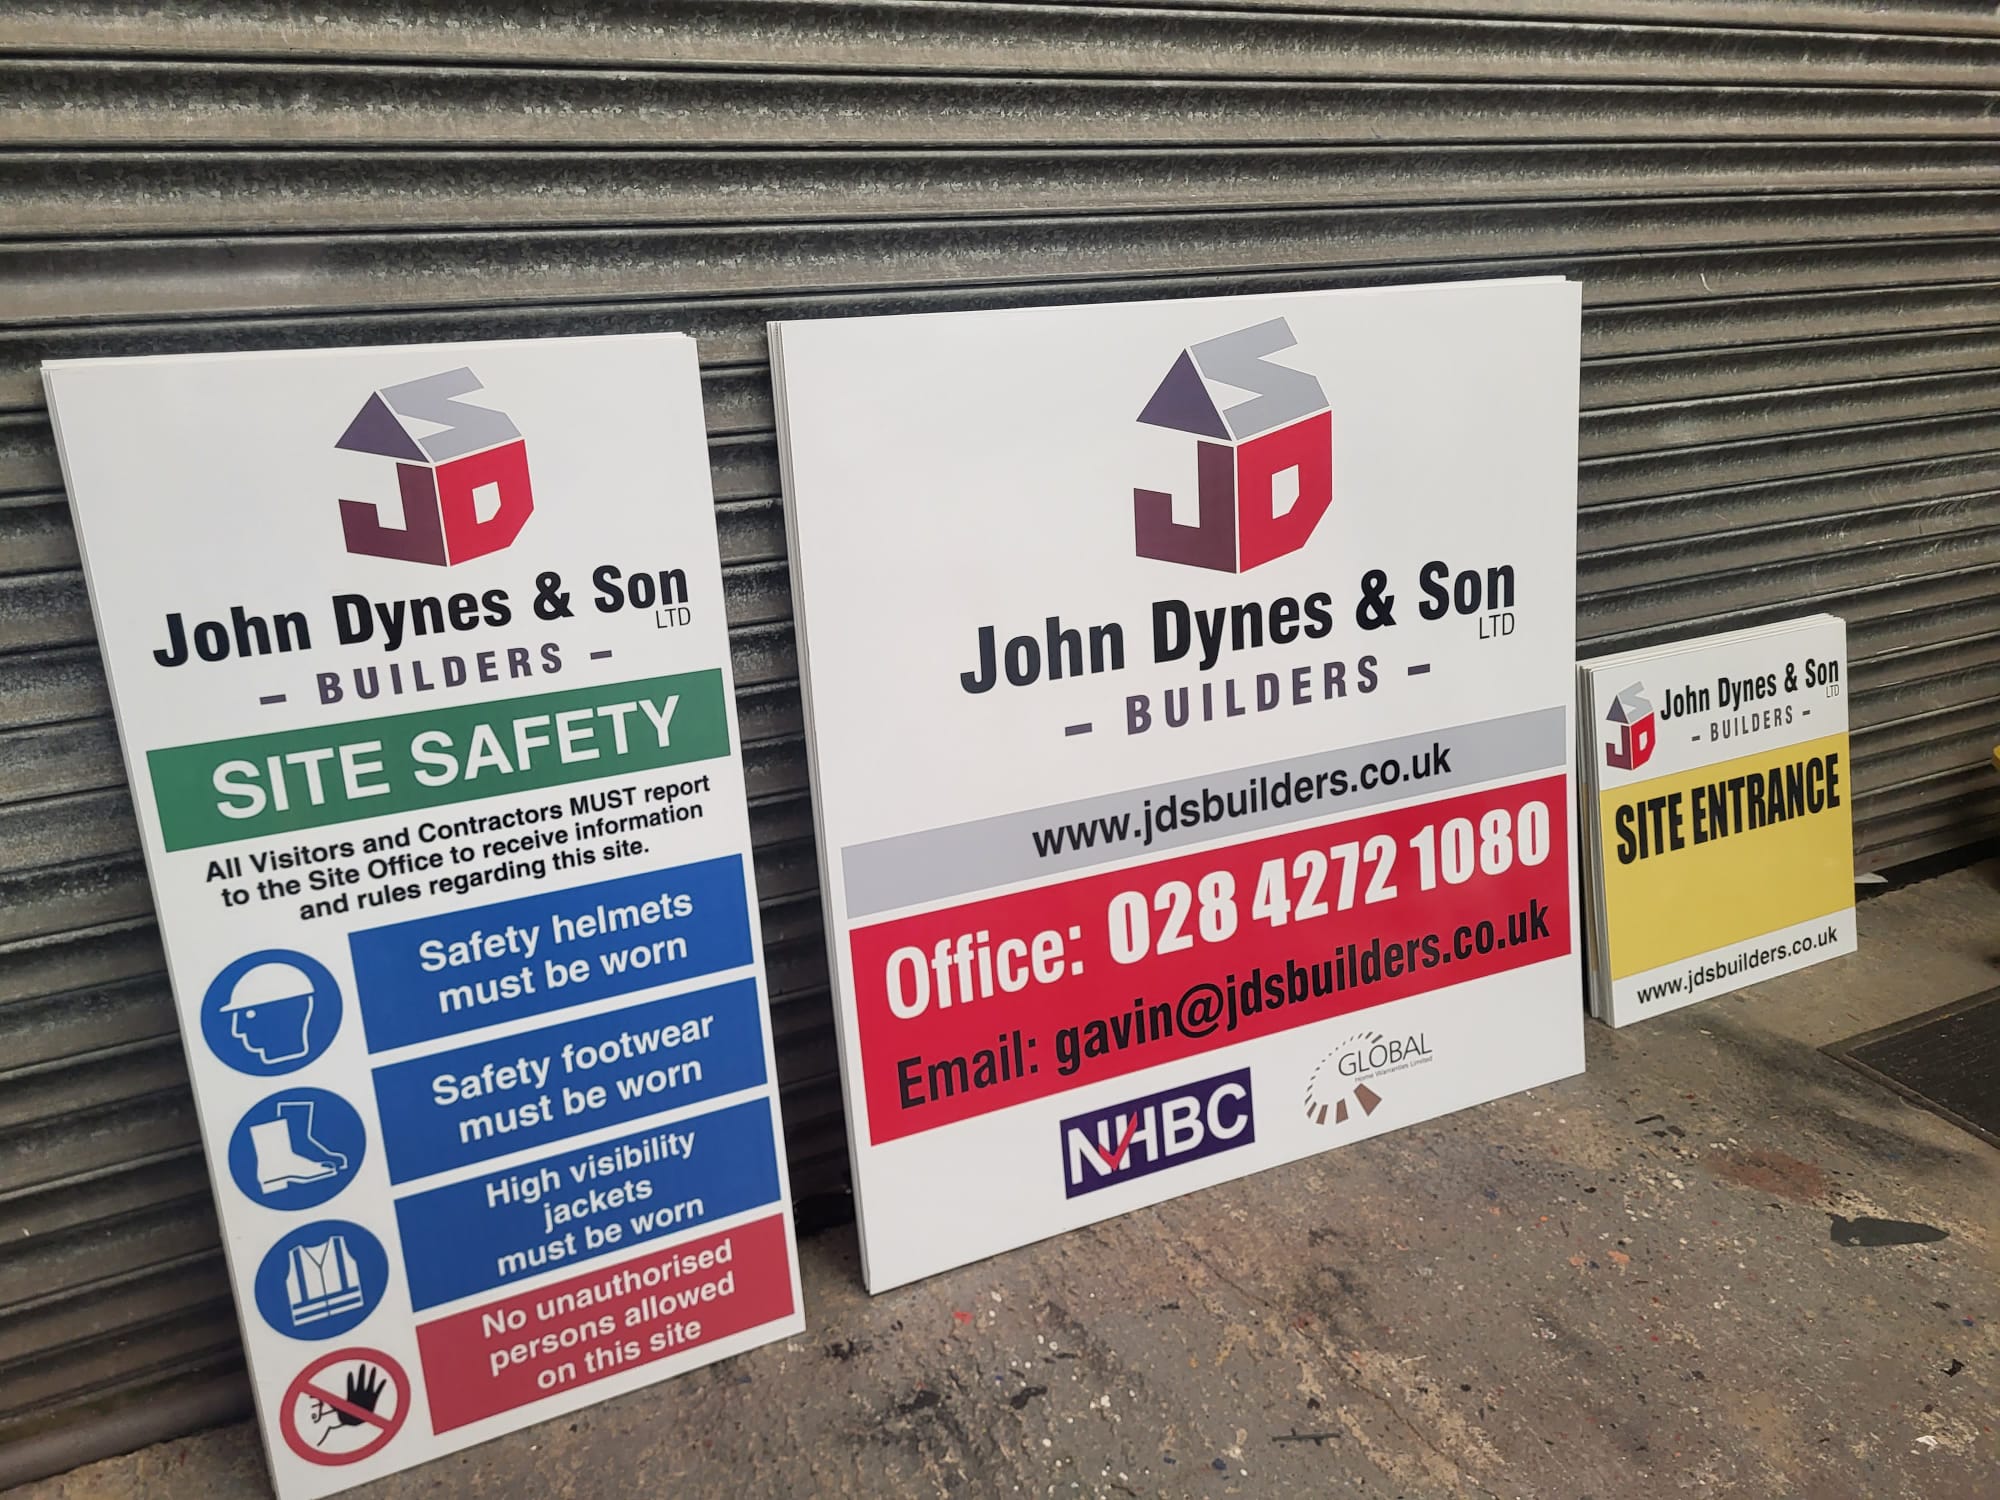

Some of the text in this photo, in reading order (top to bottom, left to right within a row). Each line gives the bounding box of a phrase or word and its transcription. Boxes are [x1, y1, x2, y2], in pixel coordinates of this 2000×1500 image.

[153, 565, 688, 667] John Dynes & Son
[656, 607, 690, 628] LTD
[960, 561, 1514, 694] John Dynes & Son
[1480, 613, 1514, 639] LTD
[317, 643, 561, 704] BUILDERS
[1126, 656, 1377, 735] BUILDERS
[1661, 659, 1838, 720] John Dynes & Son
[1827, 685, 1840, 698] LTD
[213, 695, 679, 818] SITE SAFETY
[1711, 705, 1792, 741] BUILDERS
[207, 775, 710, 882] All Visitors and Contractors MUST report
[1032, 742, 1451, 857] www.jdsbuilders.co.uk
[1616, 753, 1840, 864] SITE ENTRANCE
[221, 804, 703, 907] to the Site Office to receive information
[300, 840, 648, 920] and rules regarding this site.
[420, 894, 692, 971] Safety helmets
[886, 801, 1549, 1018] Office: 028 4272 1080
[439, 938, 687, 1013] must be worn
[897, 899, 1550, 1109] Email: gavin@jdsbuilders.co.uk
[1637, 926, 1837, 1004] www.jdsbuilders.co.uk
[433, 1016, 713, 1105] Safety footwear
[1338, 1033, 1433, 1079] GLOBAL
[460, 1061, 701, 1143] must be worn
[1067, 1081, 1250, 1186] NHBC
[487, 1133, 694, 1208] High visibility
[544, 1180, 654, 1234] jackets
[498, 1199, 703, 1275] must be worn
[483, 1238, 733, 1337] No unauthorised
[490, 1268, 734, 1377] persons allowed
[538, 1322, 700, 1388] on this site
